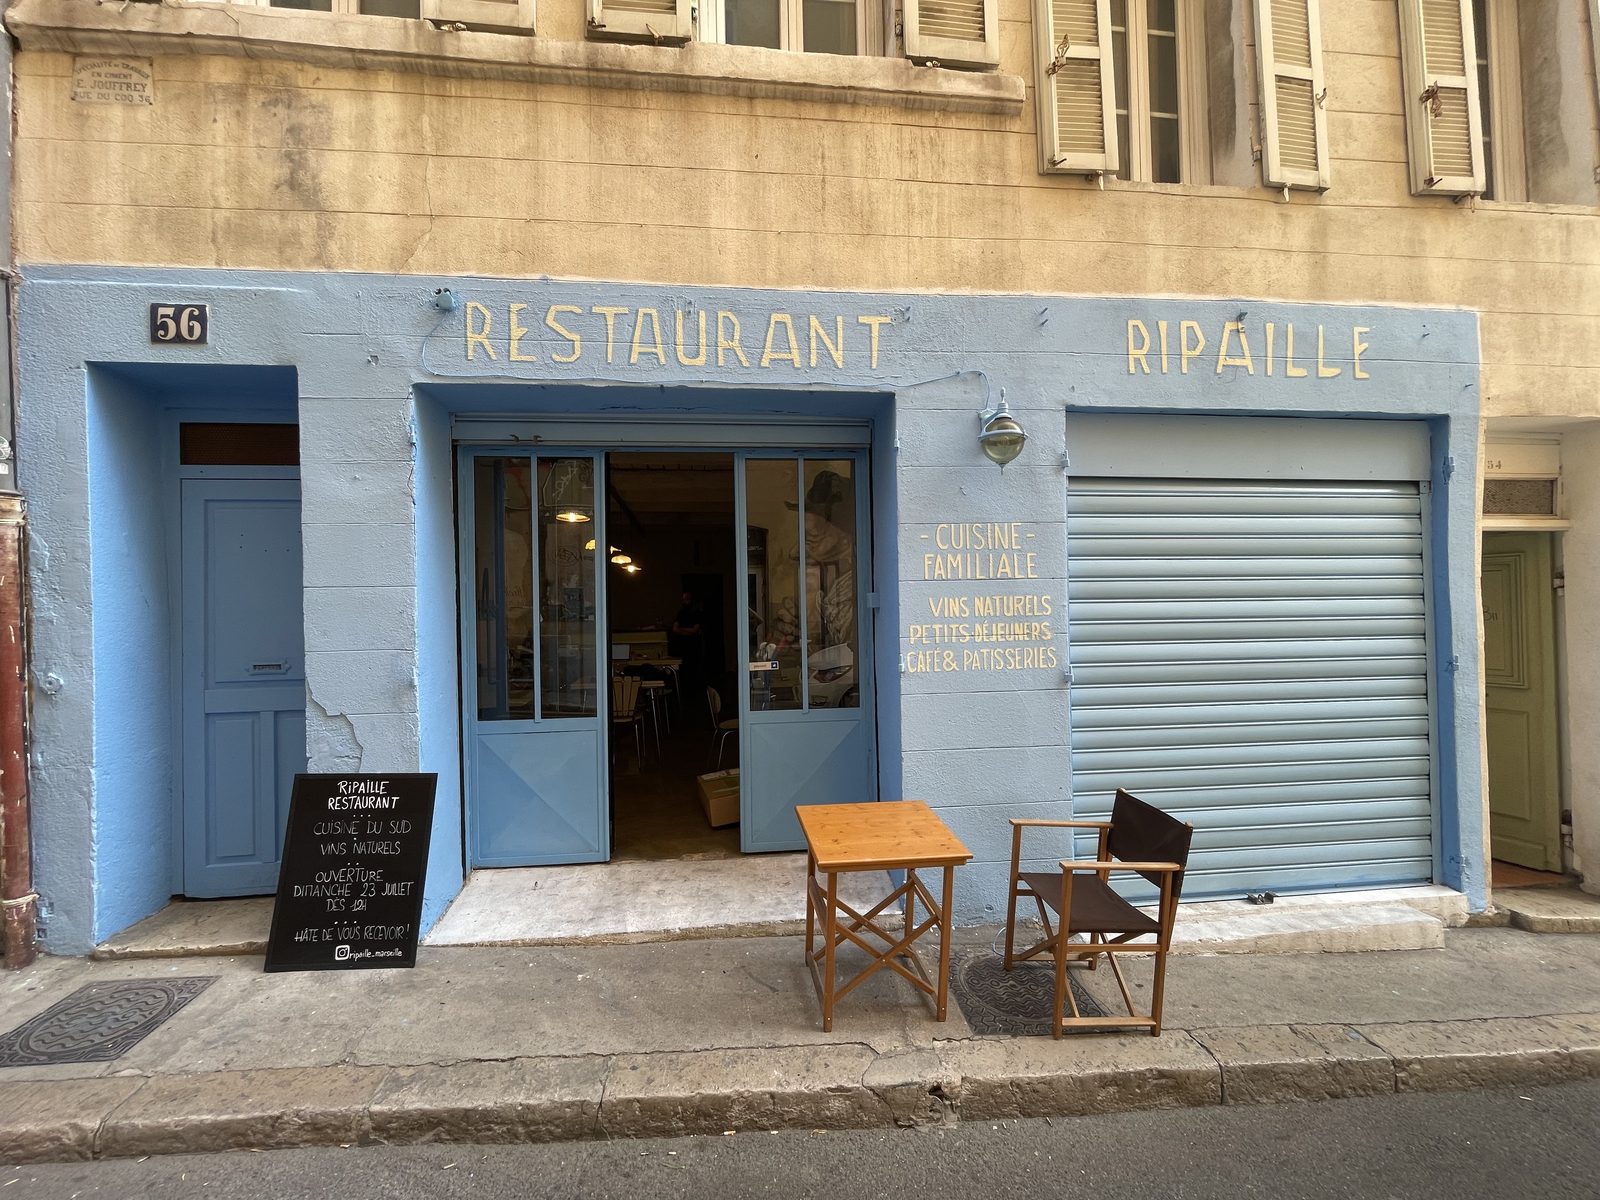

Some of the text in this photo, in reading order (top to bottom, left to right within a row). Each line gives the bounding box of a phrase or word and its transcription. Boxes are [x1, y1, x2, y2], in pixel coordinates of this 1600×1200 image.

[104, 72, 133, 80] CIMENT
[90, 81, 147, 93] JOUFFREY
[73, 91, 151, 104] RUE DU COQ 36
[156, 307, 202, 341] 56
[466, 301, 1371, 379] RESTAURANT RIPAILLE
[923, 552, 1039, 580] FAMILIALE
[928, 595, 1052, 618] VINS NATURELS
[909, 620, 1052, 645] PETITS DÉJEUNERS
[963, 646, 1058, 672] PATISSERIES
[328, 796, 401, 811] RESTAURANT
[366, 820, 383, 834] DU
[389, 819, 412, 834] SUD
[353, 840, 401, 855] NATURELS
[315, 868, 384, 883] OUVERTURE
[293, 881, 415, 898] DIMANCHE 23 JUILLET
[294, 927, 319, 942] HÂTE
[322, 927, 335, 941] DE
[337, 925, 361, 941] VOUS
